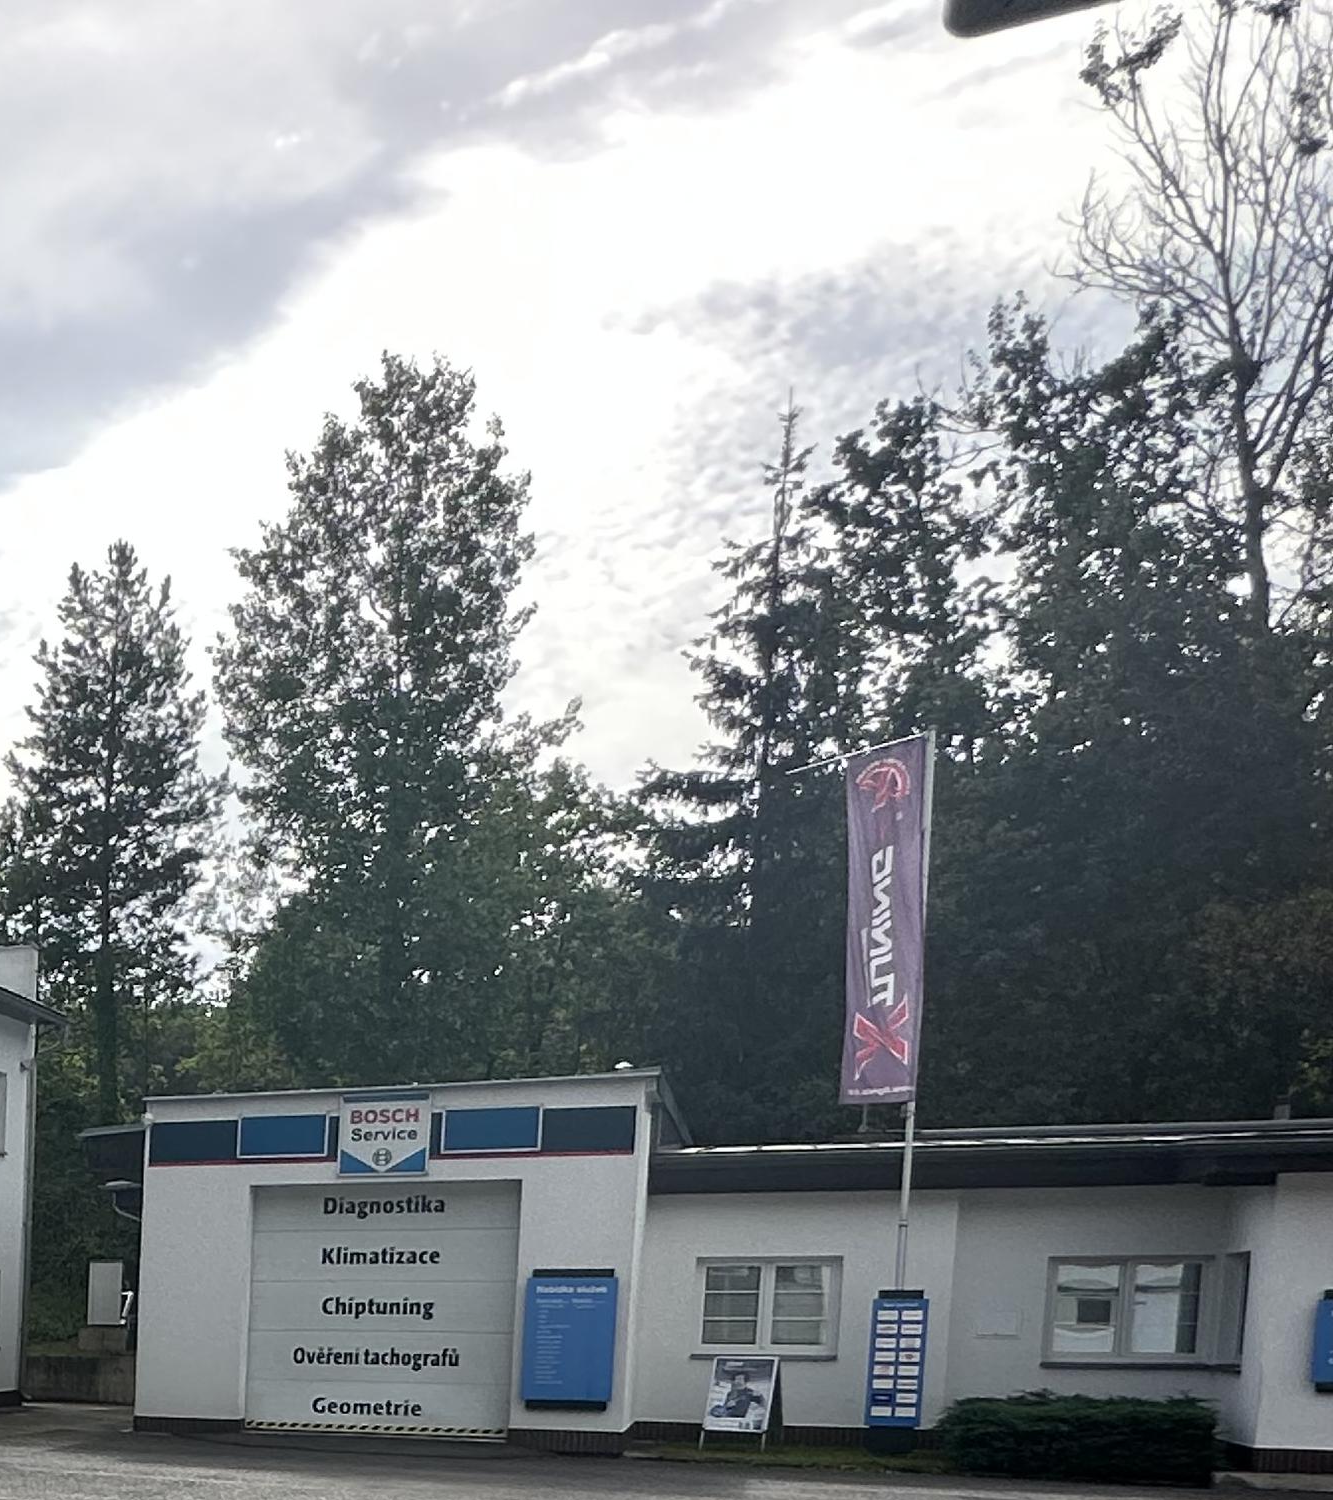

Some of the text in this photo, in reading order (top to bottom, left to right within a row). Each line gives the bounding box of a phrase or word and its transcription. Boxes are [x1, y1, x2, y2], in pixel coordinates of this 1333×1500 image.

[350, 1108, 420, 1124] BOSCH
[351, 1126, 418, 1142] Service
[323, 1195, 446, 1219] Diagnostika
[321, 1247, 441, 1265] Klimatizace
[321, 1297, 435, 1320] Chiptuning
[293, 1347, 460, 1371] Ověření tachografů
[312, 1397, 422, 1417] Geometrie
